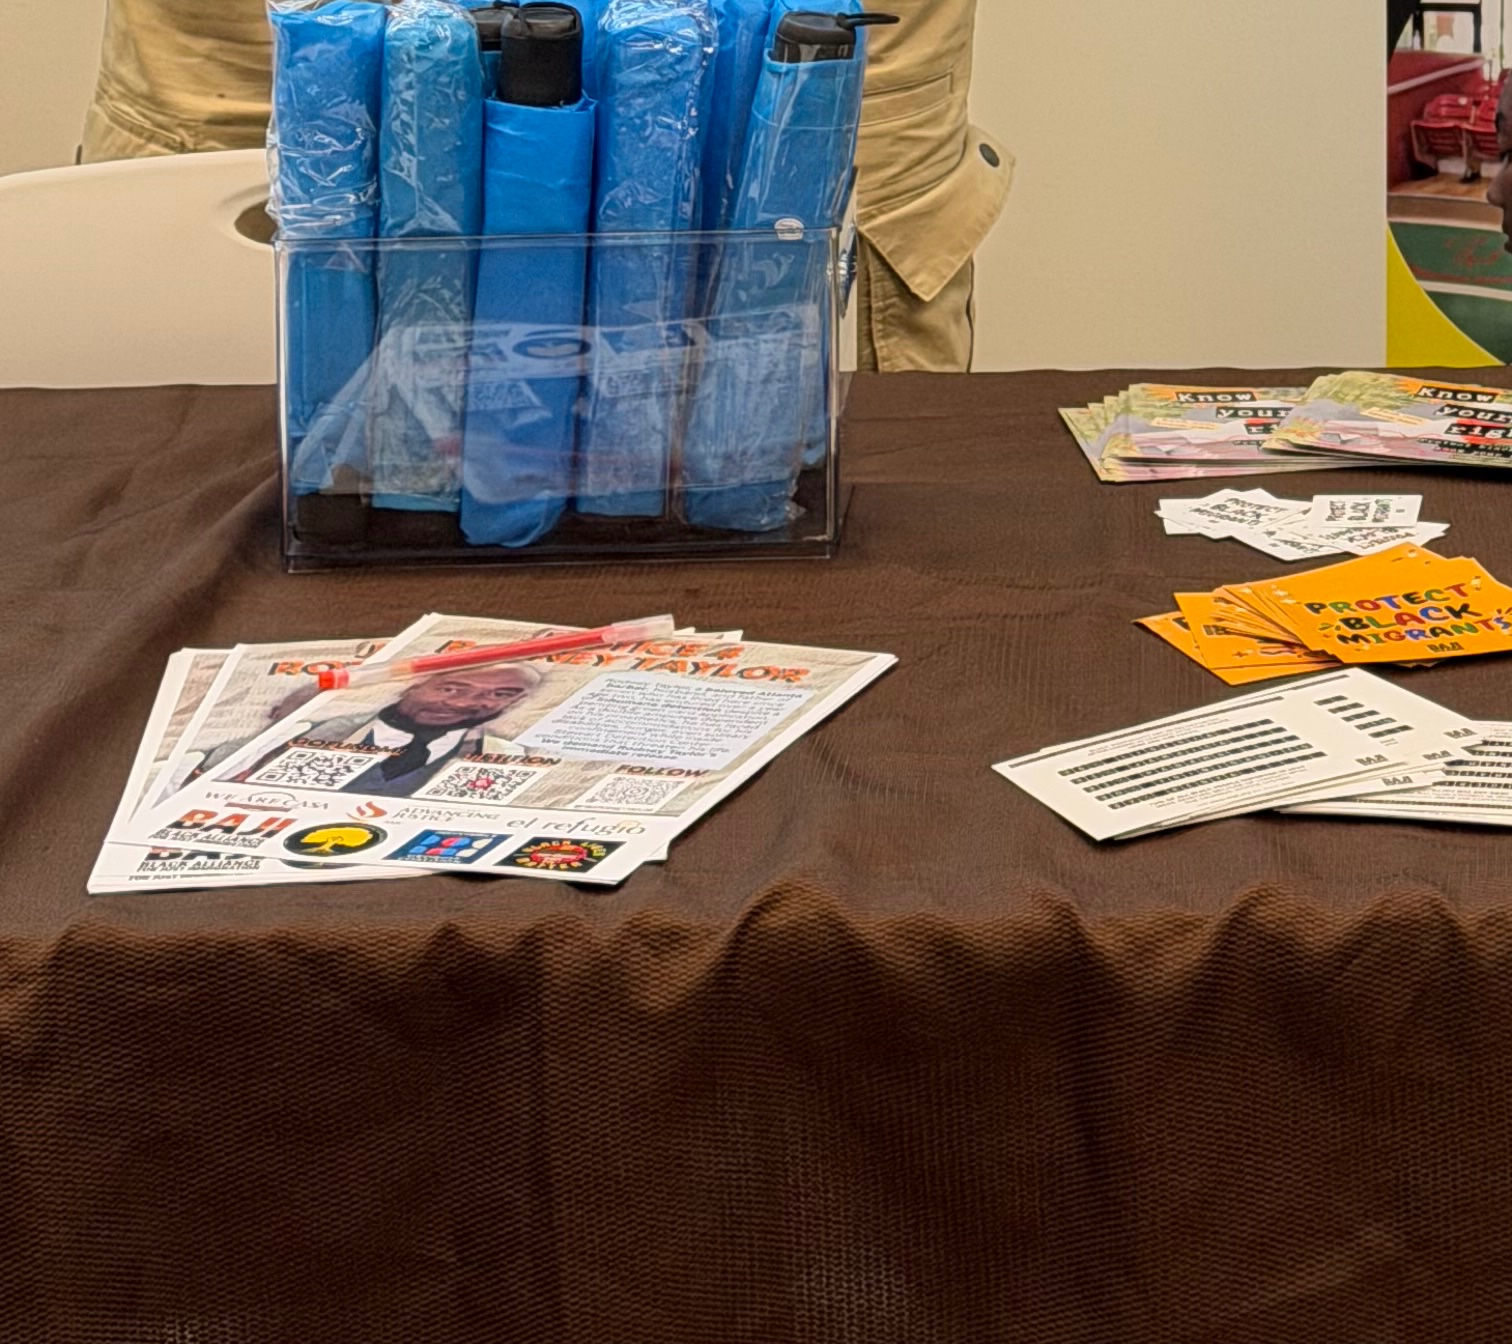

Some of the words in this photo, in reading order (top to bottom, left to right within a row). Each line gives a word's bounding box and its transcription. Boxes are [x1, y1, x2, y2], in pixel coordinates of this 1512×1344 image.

[1177, 392, 1254, 403] Know
[1418, 386, 1495, 403] Know
[1304, 582, 1469, 614] PROTECT
[1336, 616, 1512, 645] MIGRANTS
[1339, 603, 1483, 631] BLACK
[627, 657, 811, 684] TAYLOR
[615, 764, 710, 777] FOLLOW
[165, 808, 299, 839] BAJI
[506, 817, 538, 829] el
[542, 816, 646, 836] refugio
